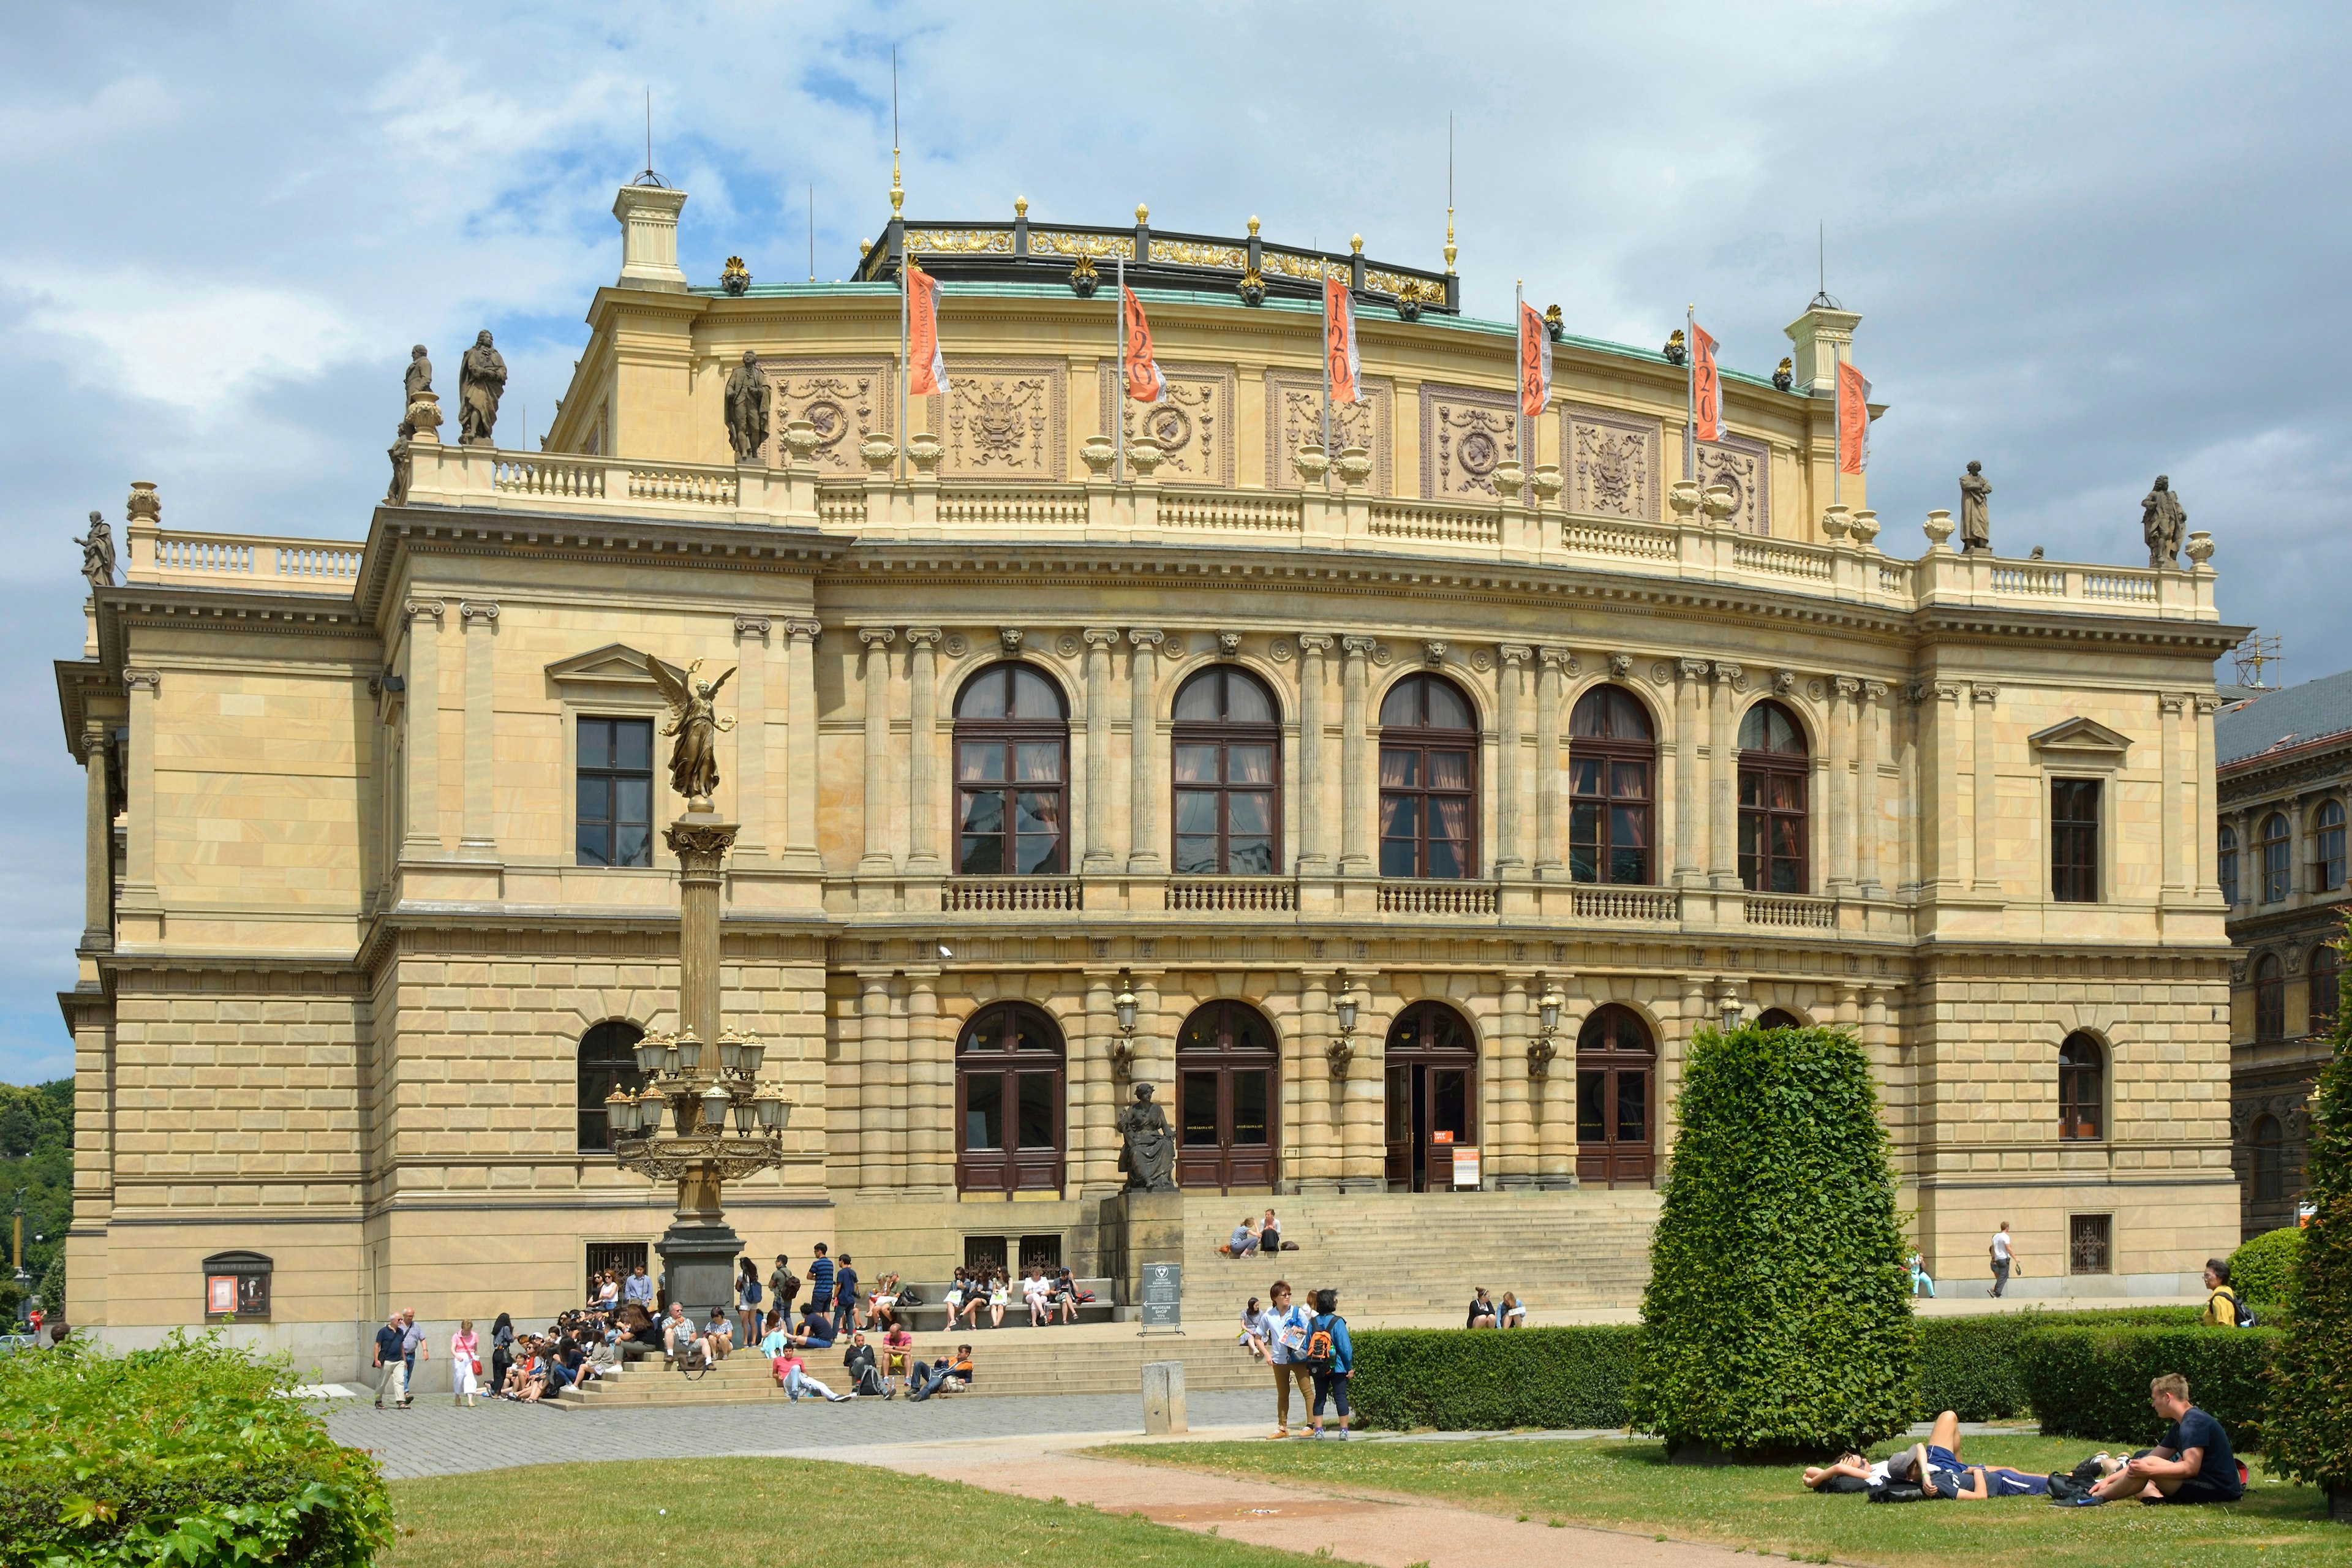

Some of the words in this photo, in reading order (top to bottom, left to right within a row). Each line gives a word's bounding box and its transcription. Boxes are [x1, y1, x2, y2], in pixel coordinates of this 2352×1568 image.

[1130, 300, 1152, 385] 120
[1331, 293, 1348, 384] 120
[1525, 312, 1540, 399] 120
[1698, 337, 1713, 423] 120
